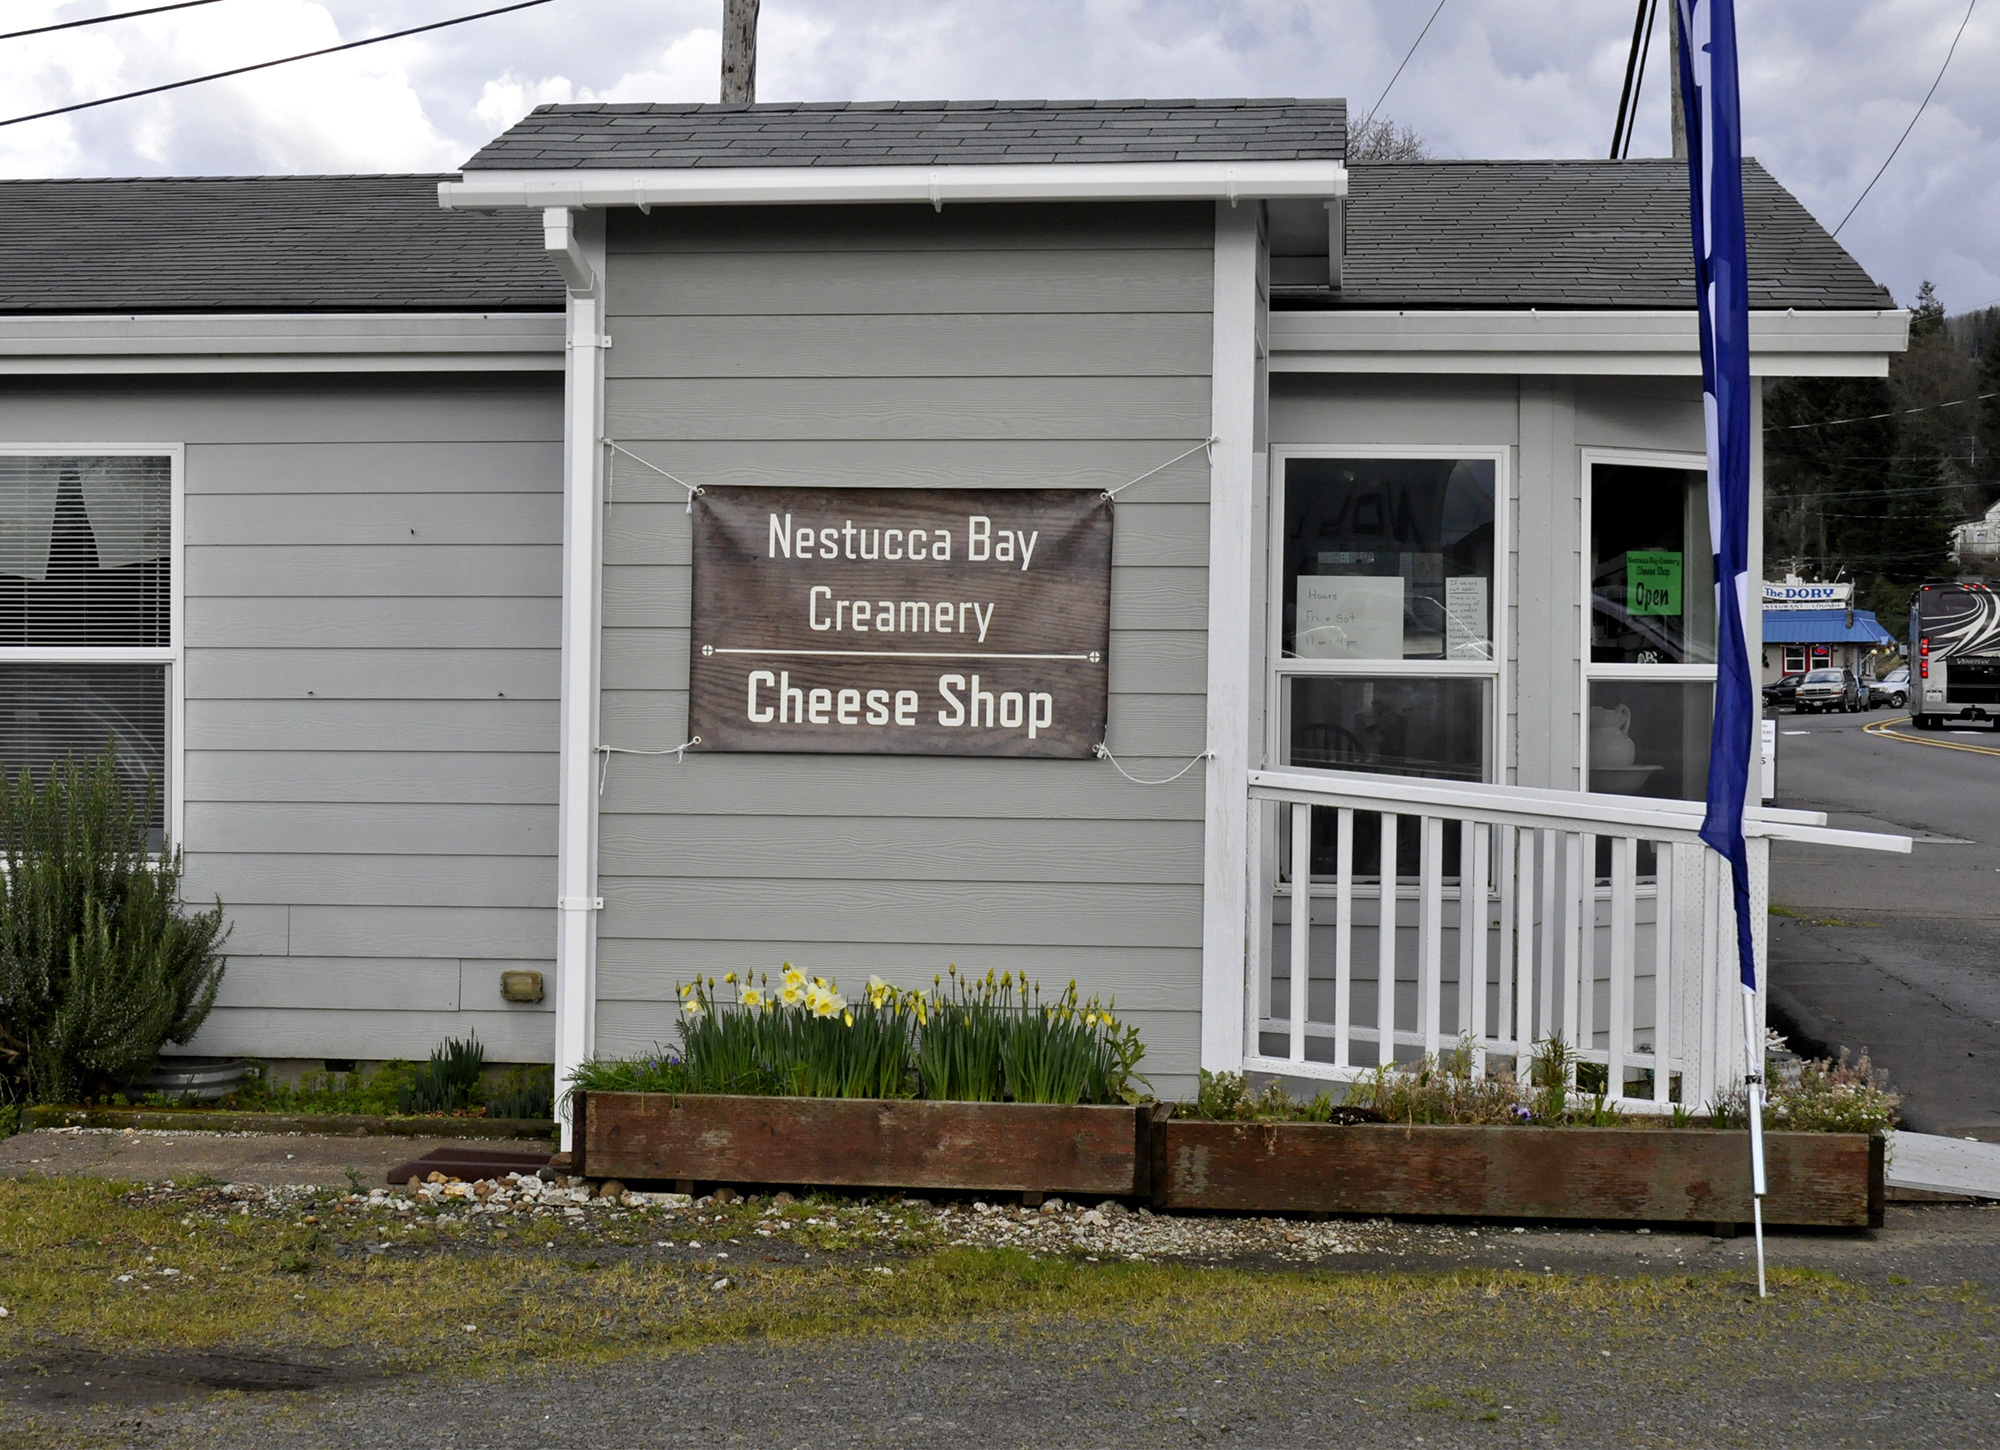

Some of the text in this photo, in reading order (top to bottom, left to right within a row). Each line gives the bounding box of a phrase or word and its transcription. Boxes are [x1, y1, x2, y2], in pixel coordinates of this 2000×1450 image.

[769, 514, 1038, 570] Nestucca Bay
[1656, 566, 1670, 578] Shop
[1308, 588, 1338, 600] Hours
[1636, 582, 1669, 611] Open
[1764, 587, 1834, 598] The DORY
[810, 586, 994, 642] Creamery
[1336, 636, 1343, 645] 4
[1346, 640, 1357, 650] pm
[748, 671, 1052, 739] Cheese Shop
